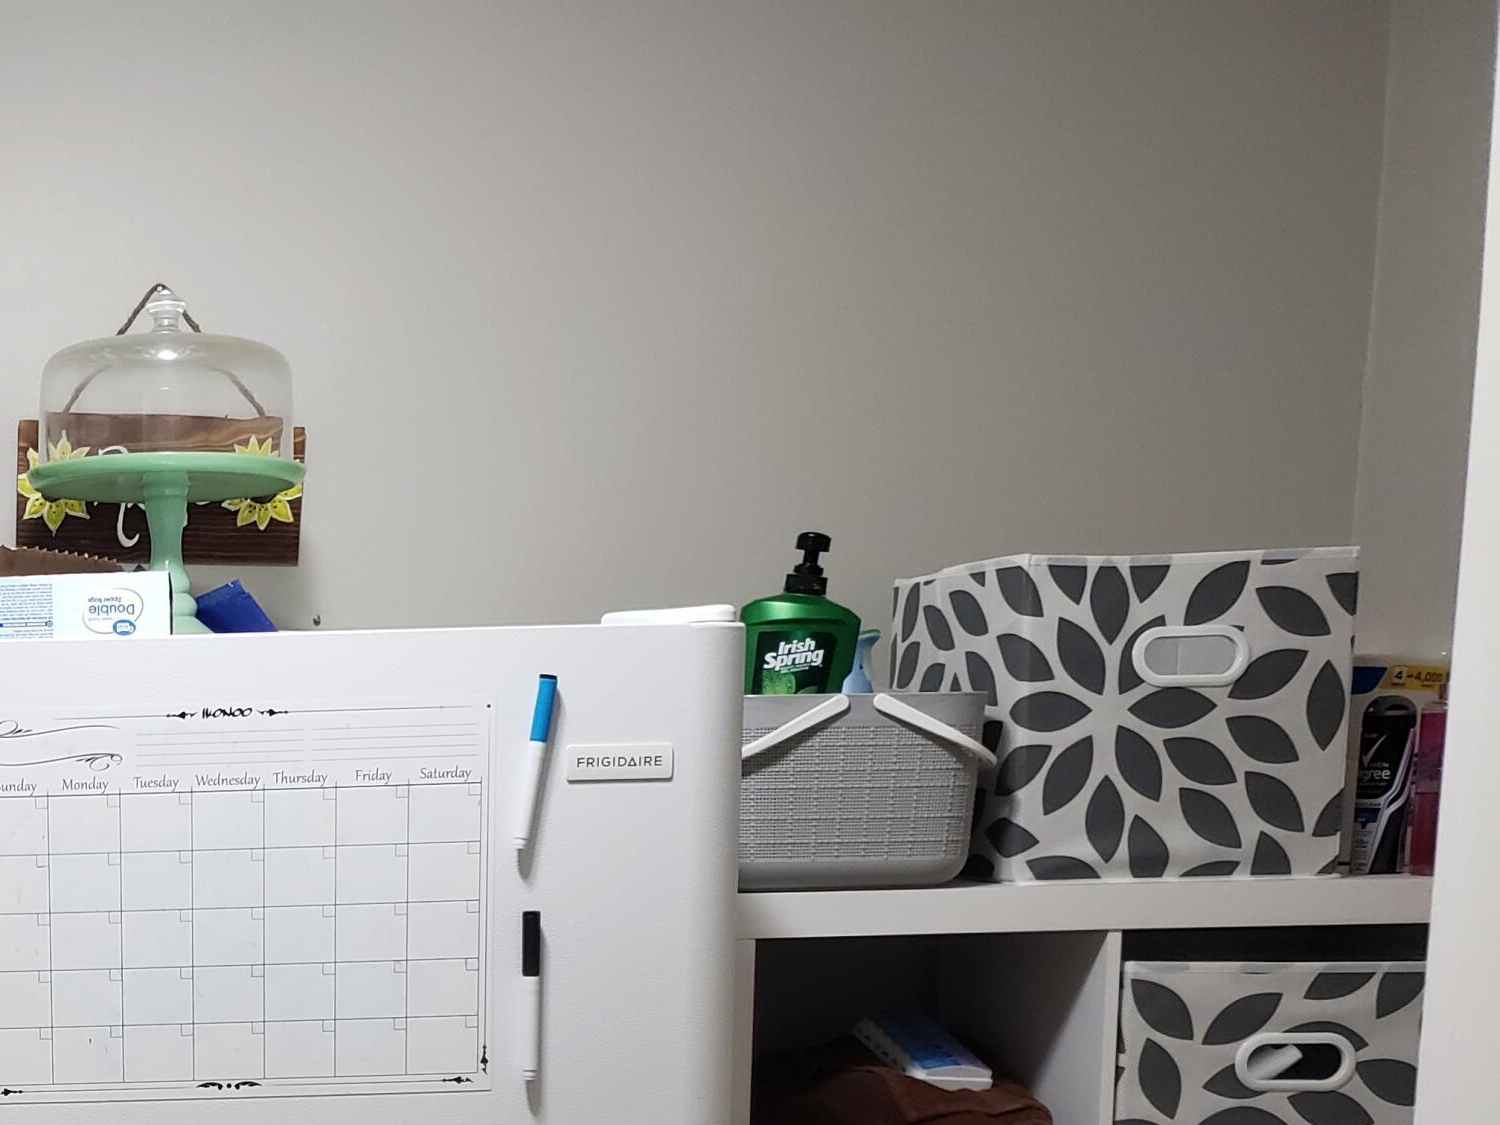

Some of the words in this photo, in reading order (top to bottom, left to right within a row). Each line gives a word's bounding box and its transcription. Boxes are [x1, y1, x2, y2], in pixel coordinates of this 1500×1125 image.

[88, 604, 135, 616] Double
[778, 638, 816, 655] Irish
[763, 650, 825, 671] Spring
[576, 755, 663, 768] FRIGIDAIRE
[61, 776, 109, 794] Monday
[133, 774, 179, 792] Tuesday
[195, 771, 260, 790] Wednesday
[273, 769, 328, 787] Thursday
[355, 768, 392, 785] Friday
[420, 765, 472, 782] Saturday
[1358, 769, 1391, 782] gree
